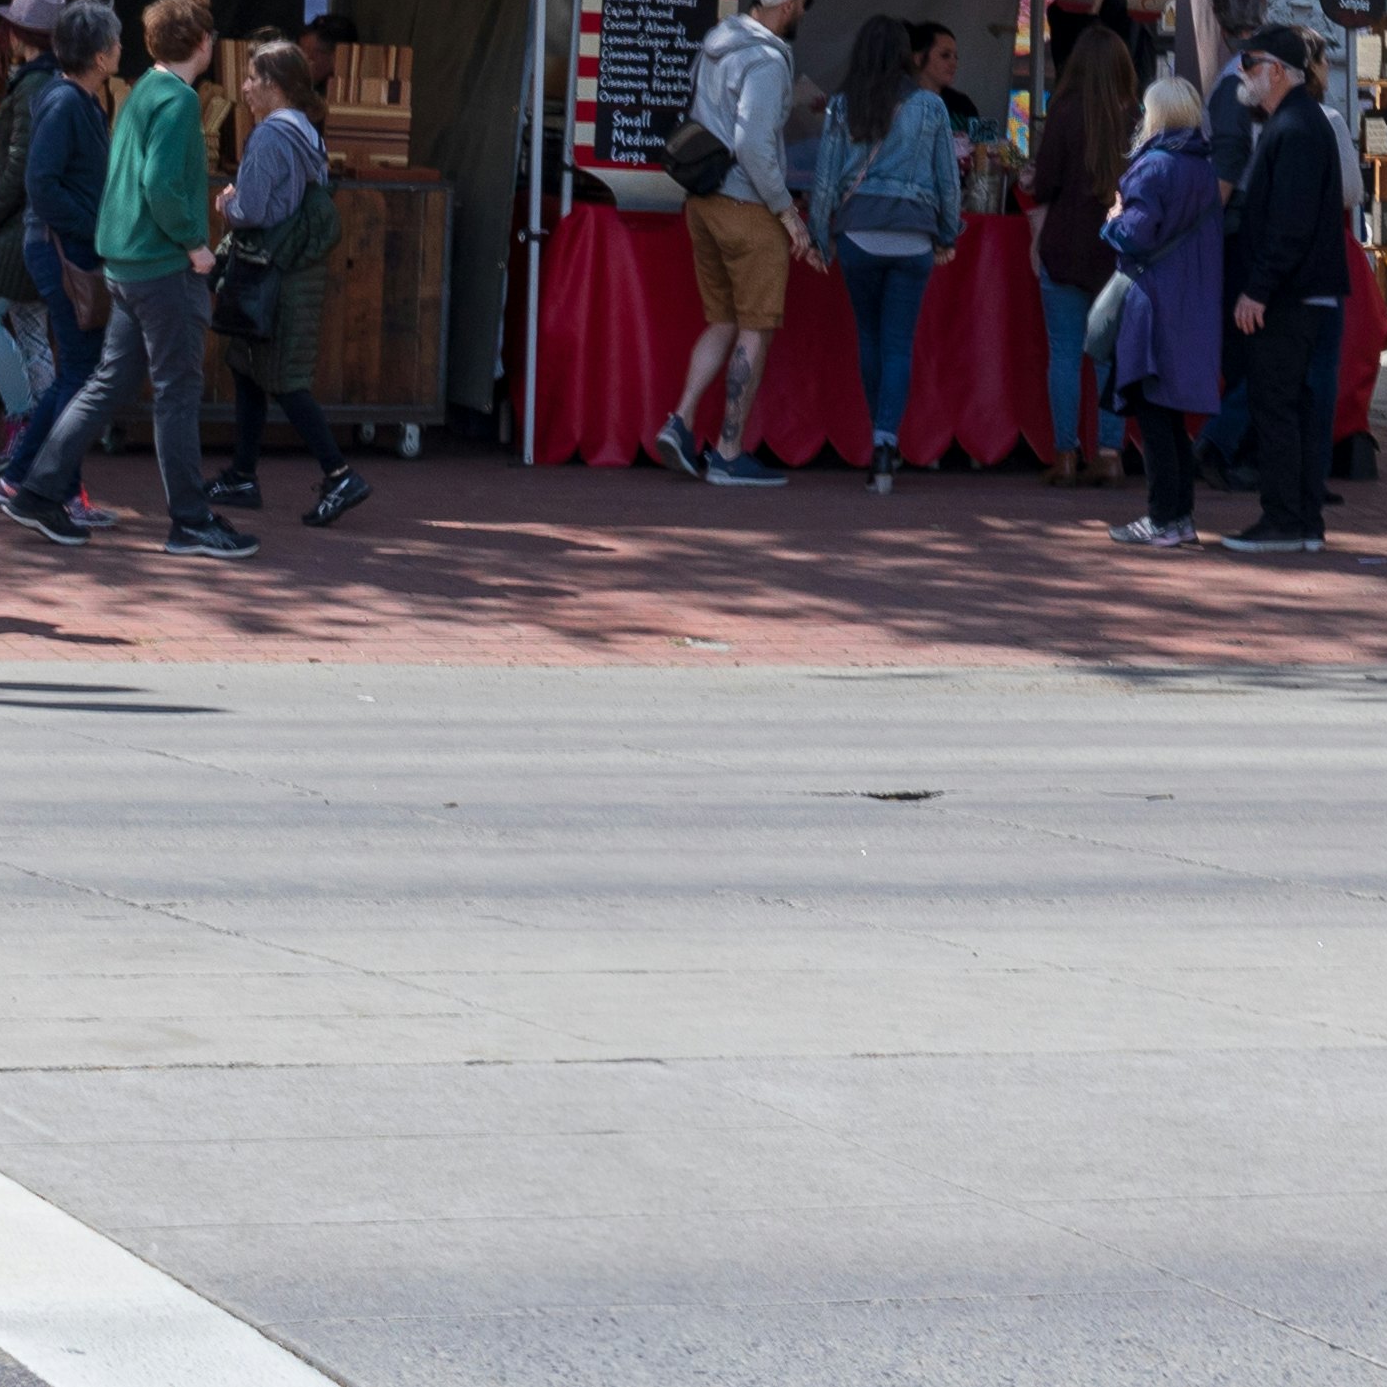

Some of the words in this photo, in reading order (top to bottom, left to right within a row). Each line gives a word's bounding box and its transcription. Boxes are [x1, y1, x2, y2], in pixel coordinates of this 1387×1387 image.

[604, 2, 633, 18] Cajun
[636, 4, 674, 20] Almond
[603, 16, 641, 31] Coconut
[644, 19, 686, 35] Almonds
[601, 46, 649, 62] Cinnamon
[599, 59, 649, 75] Cinnamon
[599, 73, 648, 89] Cinnamon
[598, 89, 635, 106] Orange
[612, 109, 652, 128] Small
[612, 128, 665, 147] Medium
[610, 145, 647, 166] Large
